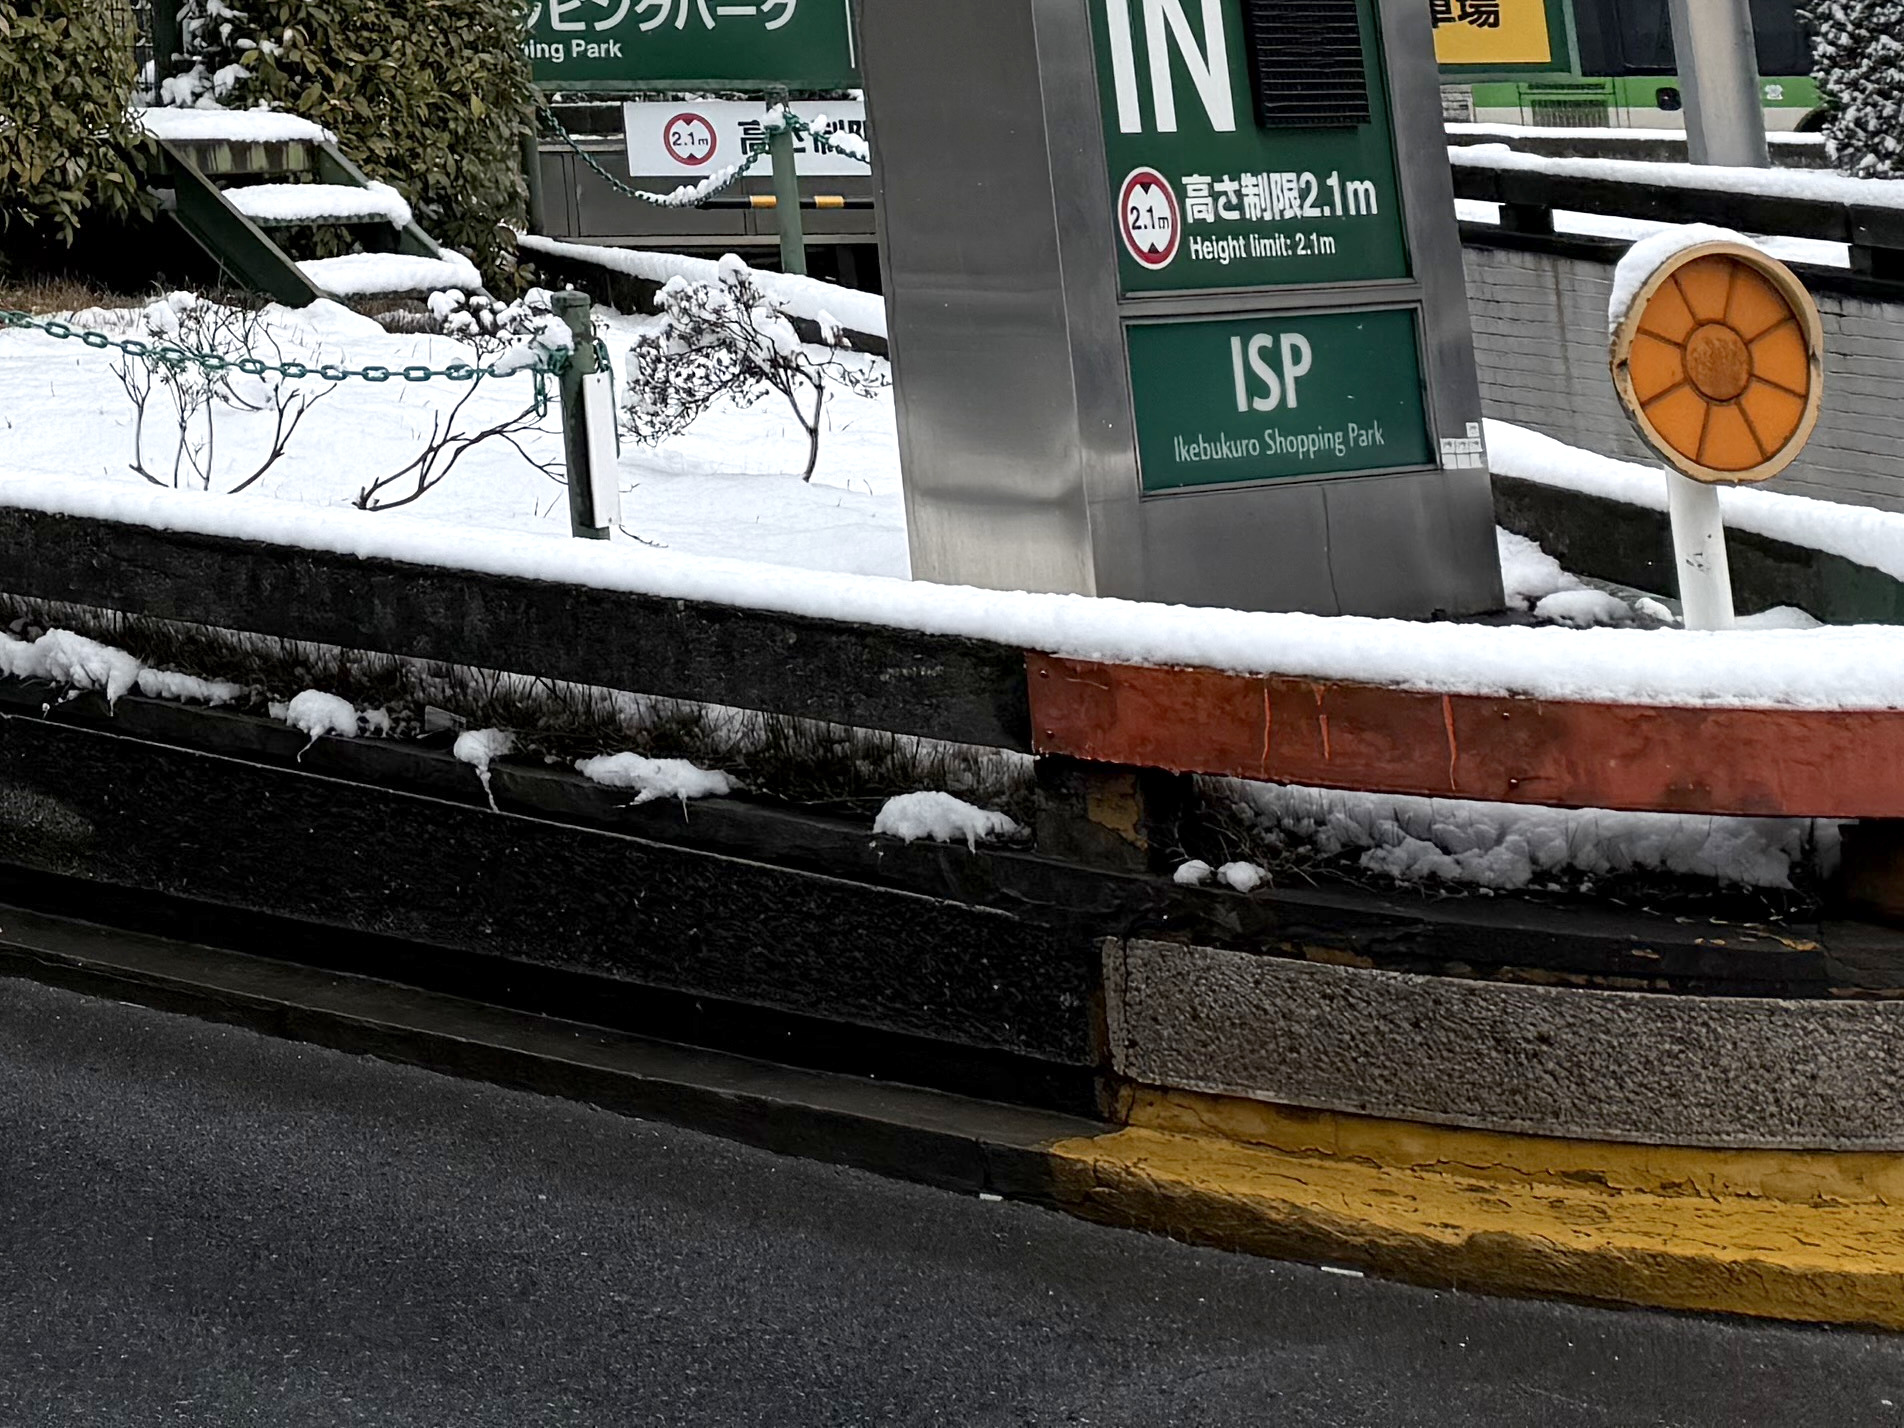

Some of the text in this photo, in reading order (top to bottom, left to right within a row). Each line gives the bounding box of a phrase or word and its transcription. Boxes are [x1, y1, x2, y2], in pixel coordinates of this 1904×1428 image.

[572, 39, 622, 59] Park
[672, 130, 710, 147] 2.1m
[1181, 170, 1379, 224] 高さ制限2.1m
[1130, 204, 1170, 231] 2.1m
[1189, 232, 1336, 265] Height limit: 2.1m
[1230, 332, 1313, 413] ISP
[1174, 418, 1385, 463] Ikebukuro Shopping Park
